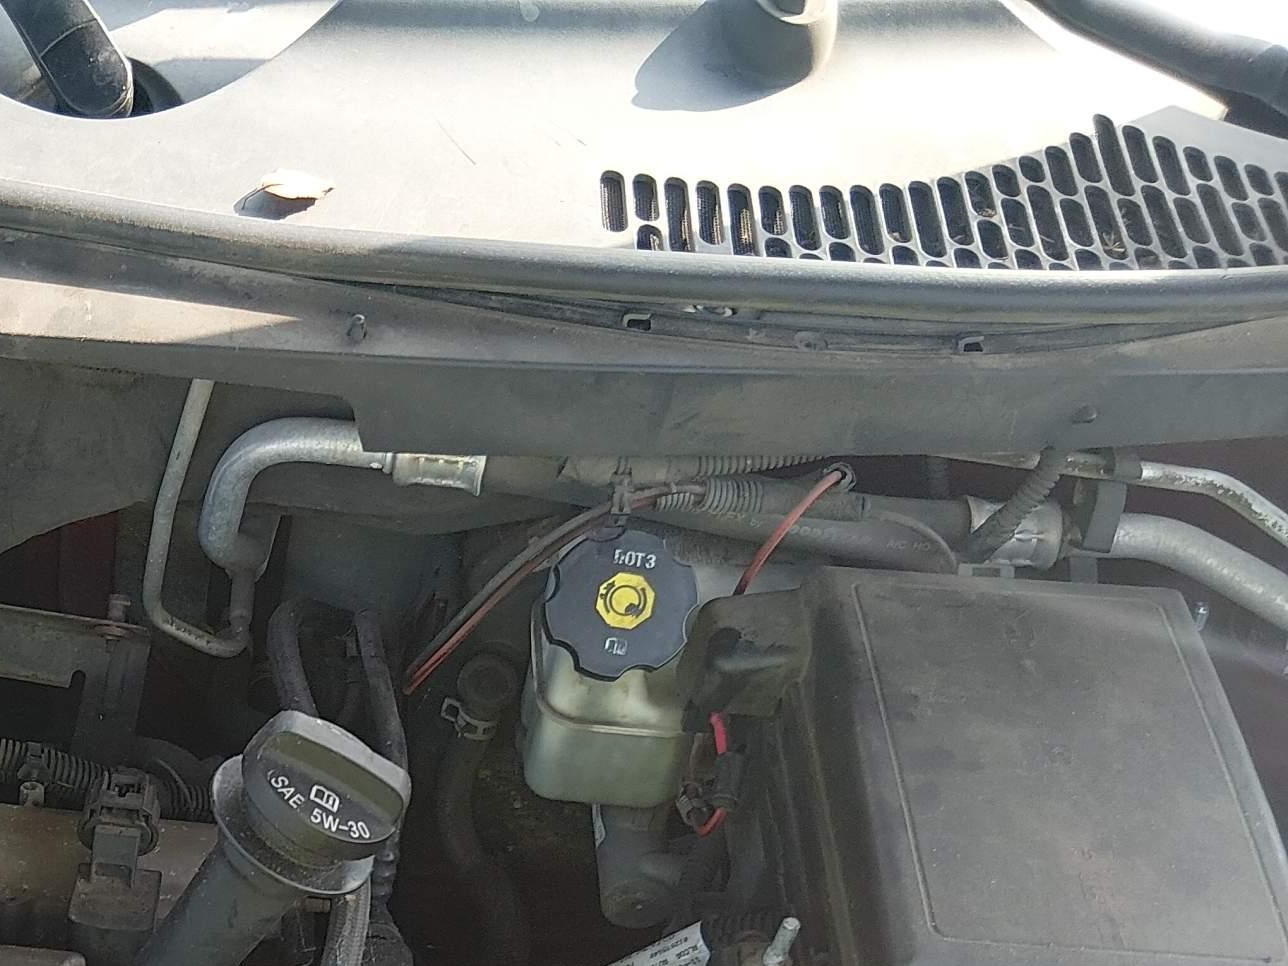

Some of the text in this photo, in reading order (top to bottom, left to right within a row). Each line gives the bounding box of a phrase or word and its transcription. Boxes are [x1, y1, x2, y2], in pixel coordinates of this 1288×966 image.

[786, 525, 872, 542] OODYEAR
[271, 775, 305, 809] SAE
[310, 808, 371, 839] 5W-30
